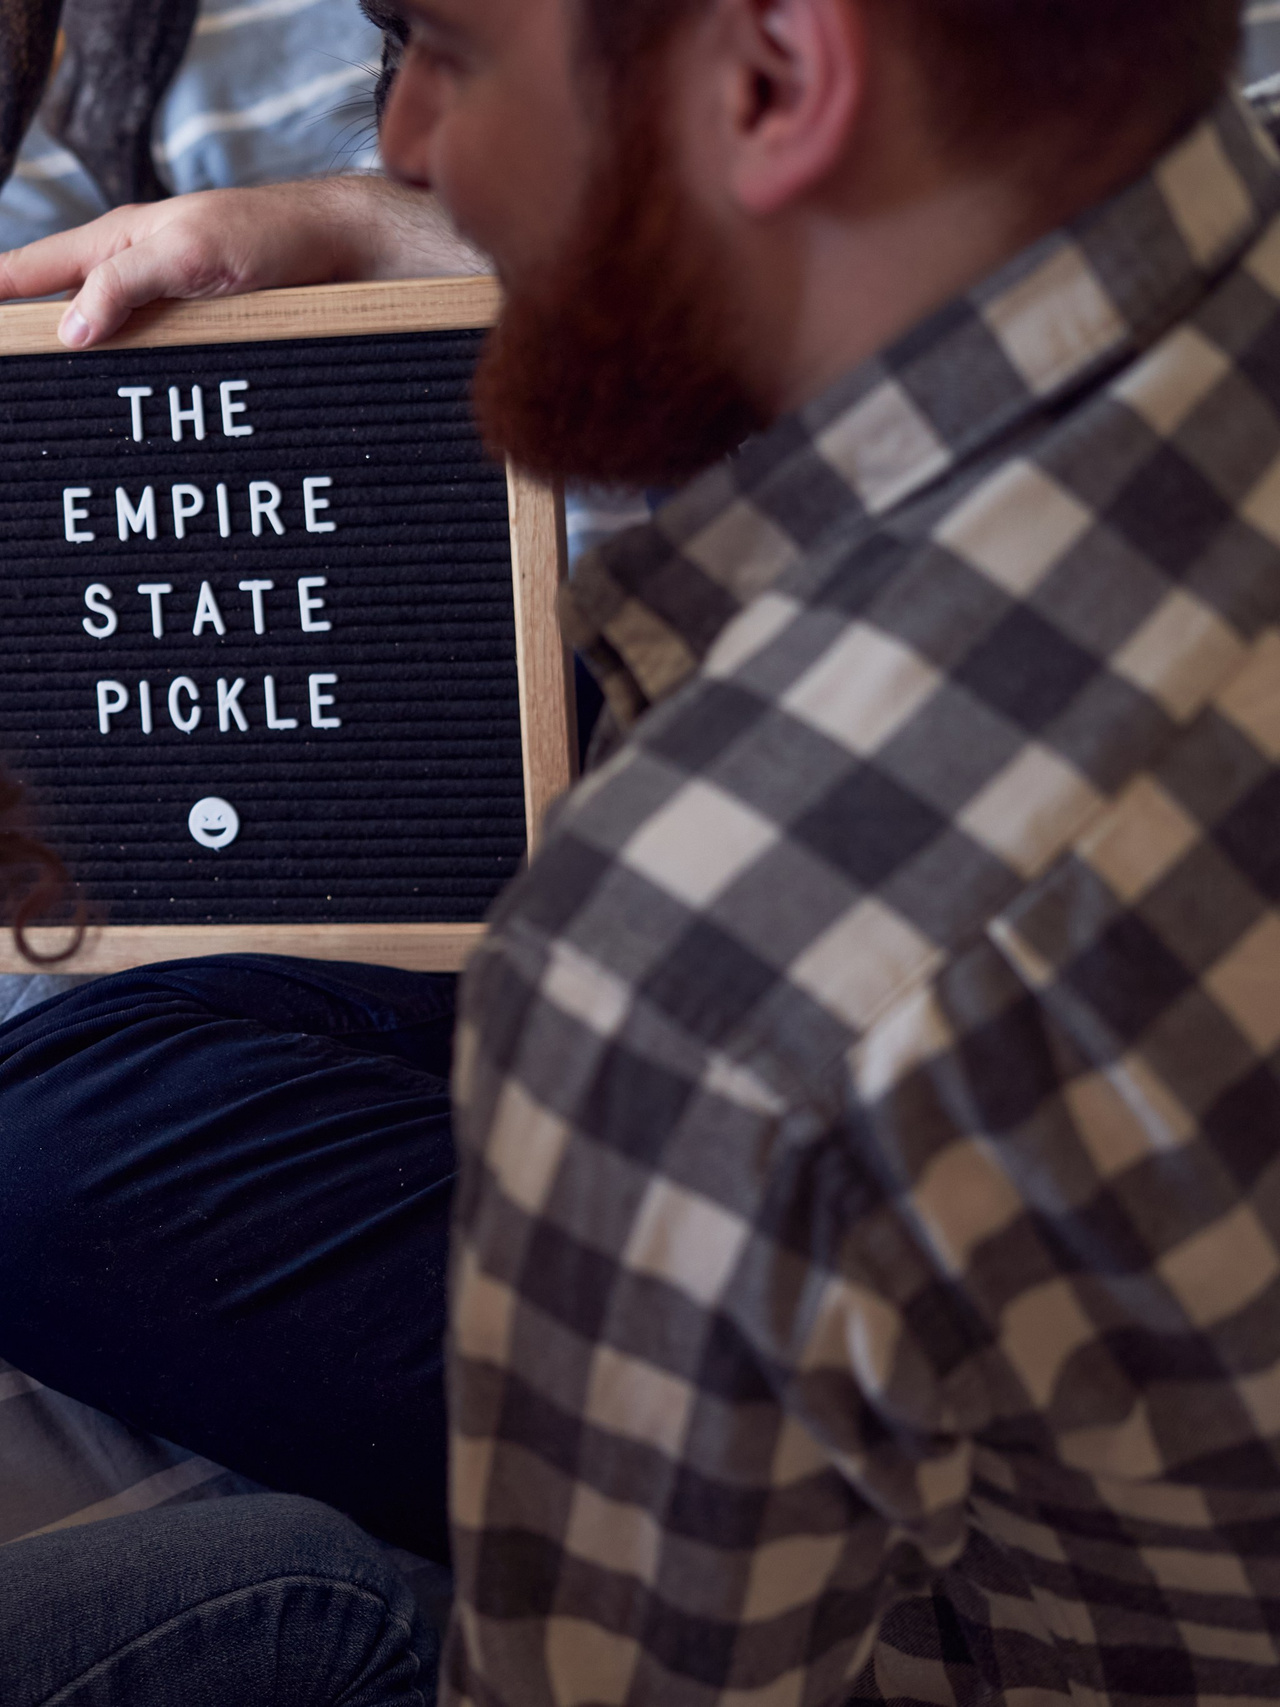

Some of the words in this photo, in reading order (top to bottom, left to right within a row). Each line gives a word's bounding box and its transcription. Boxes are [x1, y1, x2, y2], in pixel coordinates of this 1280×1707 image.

[117, 380, 253, 442] THE
[62, 476, 336, 544] EMPIRE
[82, 576, 331, 640] STATE
[96, 673, 341, 734] PICKLE
